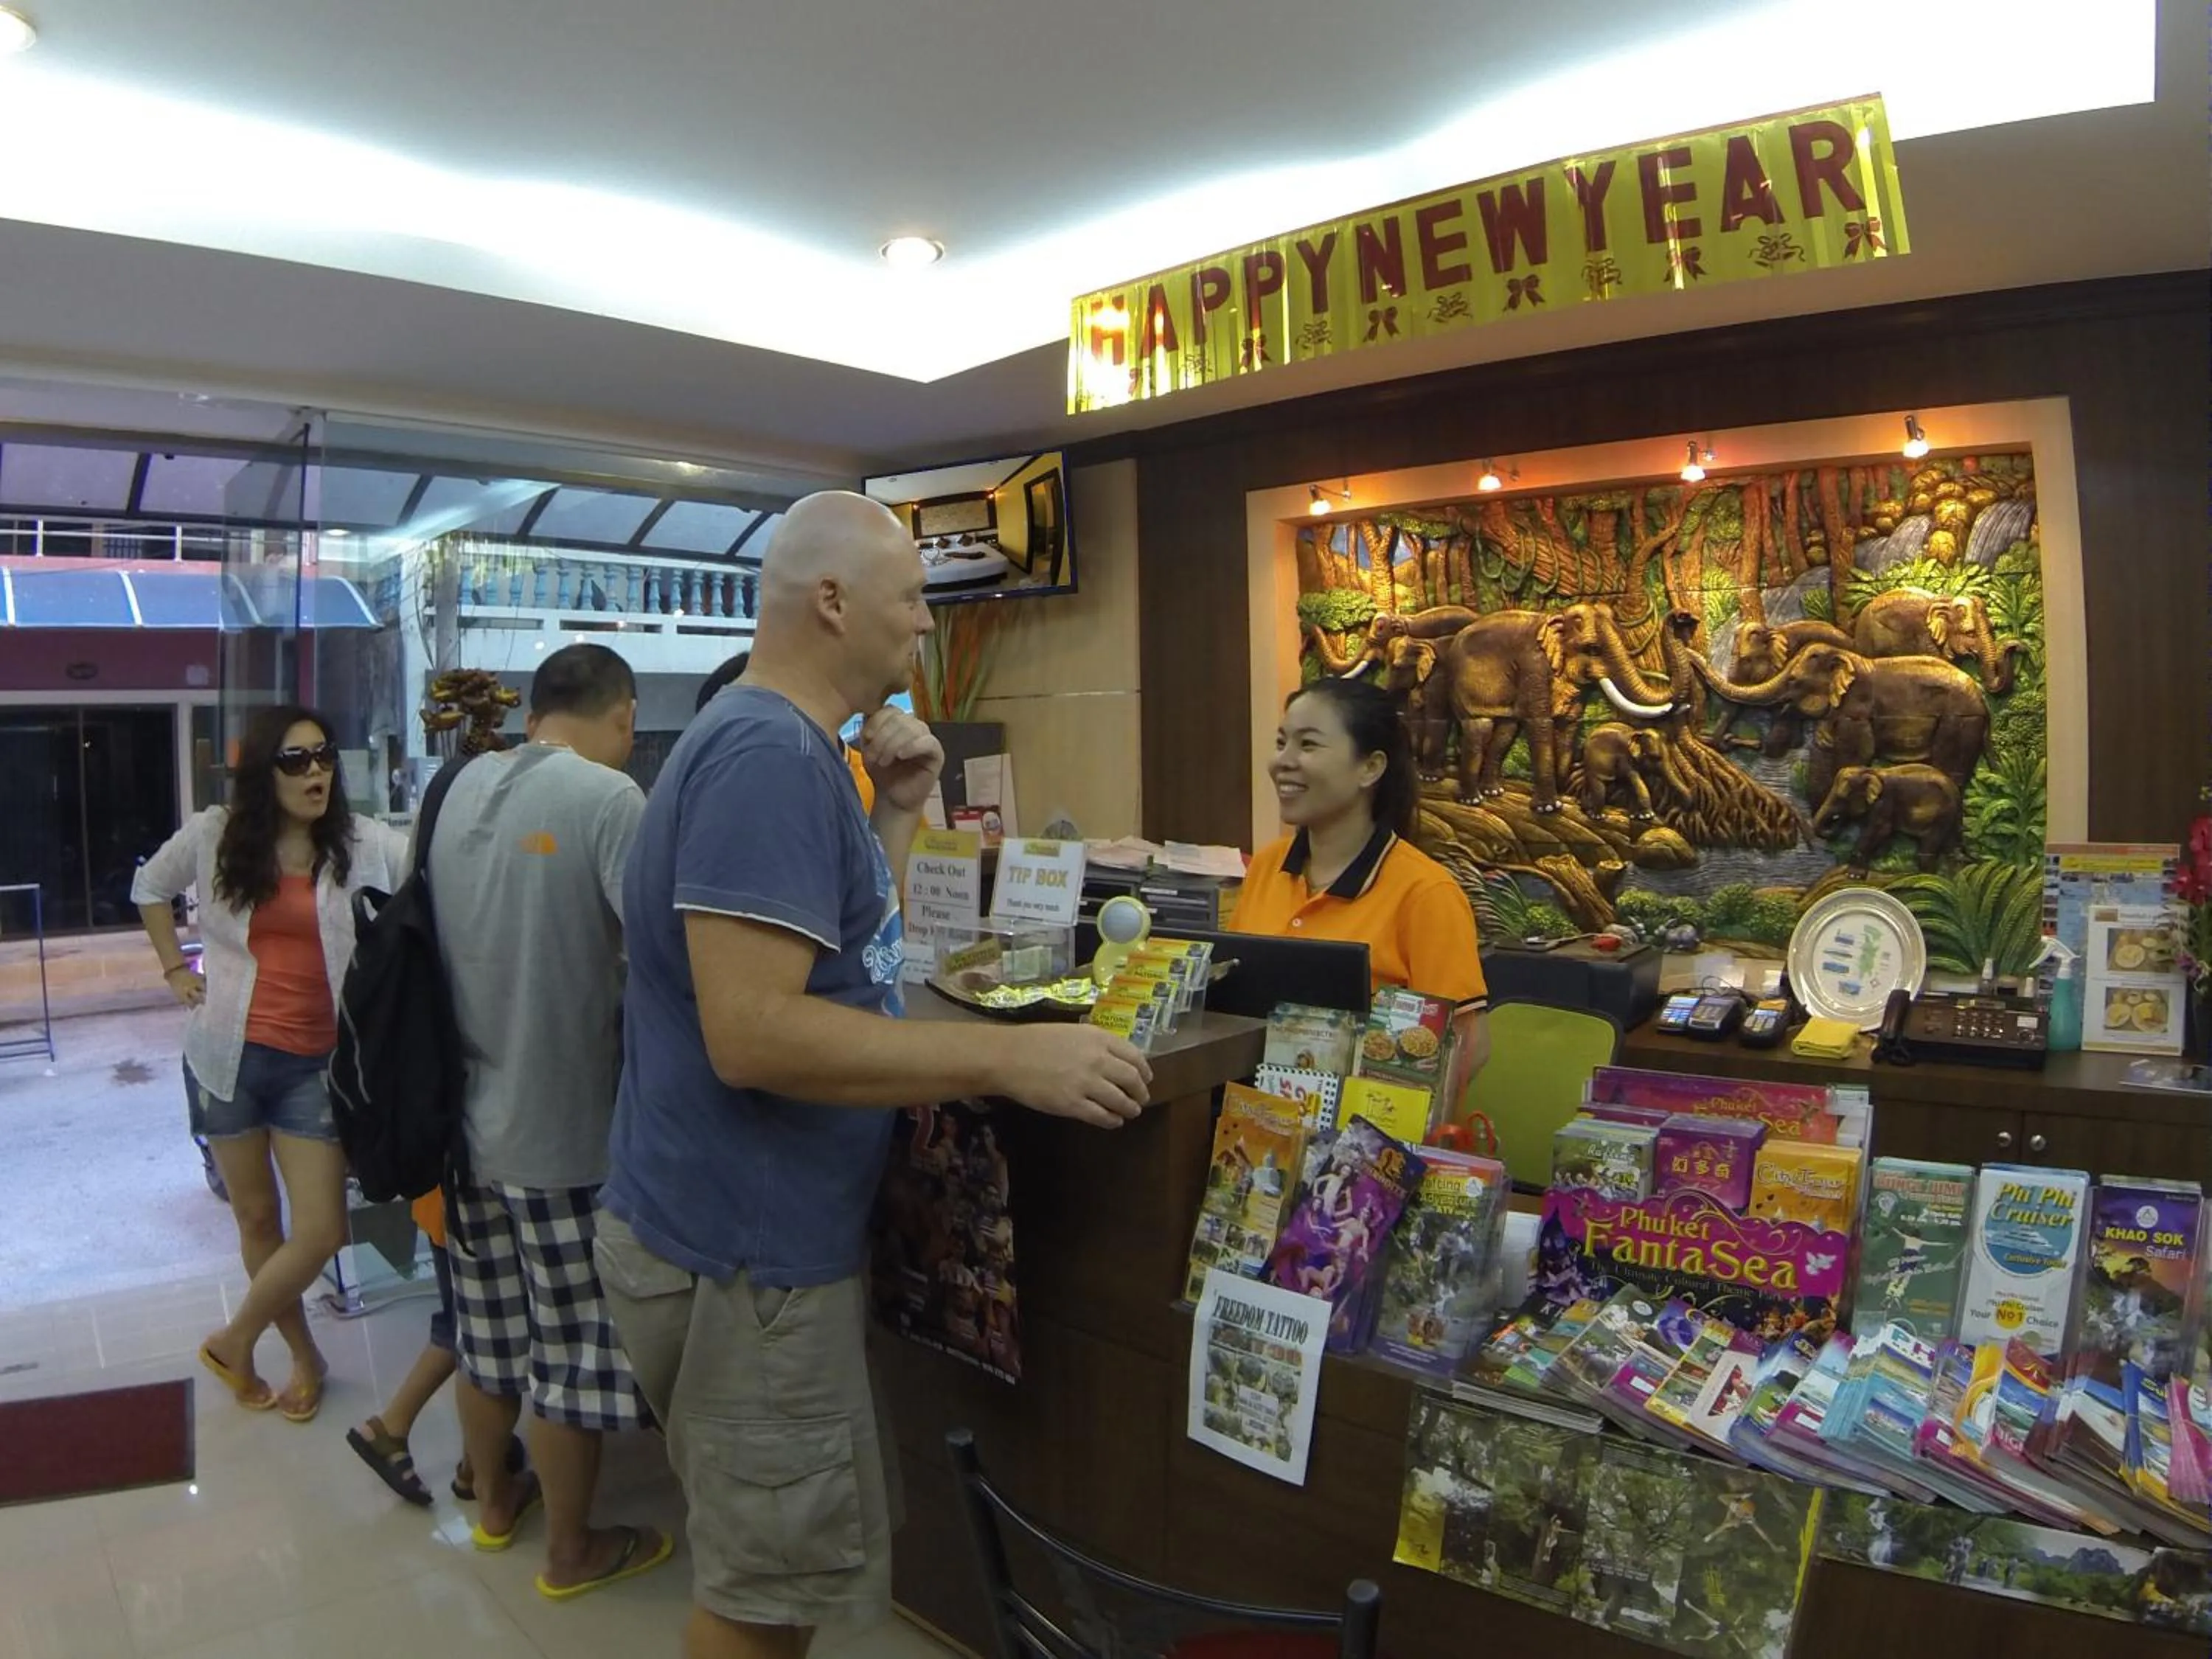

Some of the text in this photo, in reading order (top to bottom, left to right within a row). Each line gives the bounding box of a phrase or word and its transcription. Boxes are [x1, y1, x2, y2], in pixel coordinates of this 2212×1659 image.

[1087, 118, 1868, 366] HAPPY NEW YEAR
[917, 860, 966, 877] Check Out
[1008, 866, 1068, 888] TIP BOX
[922, 905, 950, 920] Please
[1999, 1181, 2077, 1210] Phi Phi
[1620, 1206, 1710, 1240] Phuket
[1991, 1201, 2074, 1228] Cruiser
[2105, 1226, 2184, 1245] KHAO SOK
[1583, 1217, 1798, 1289] FantaSea
[2146, 1245, 2187, 1260] Safari
[1213, 1295, 1309, 1346] FREEDOM TATTOO
[2025, 1315, 2059, 1328] Choice
